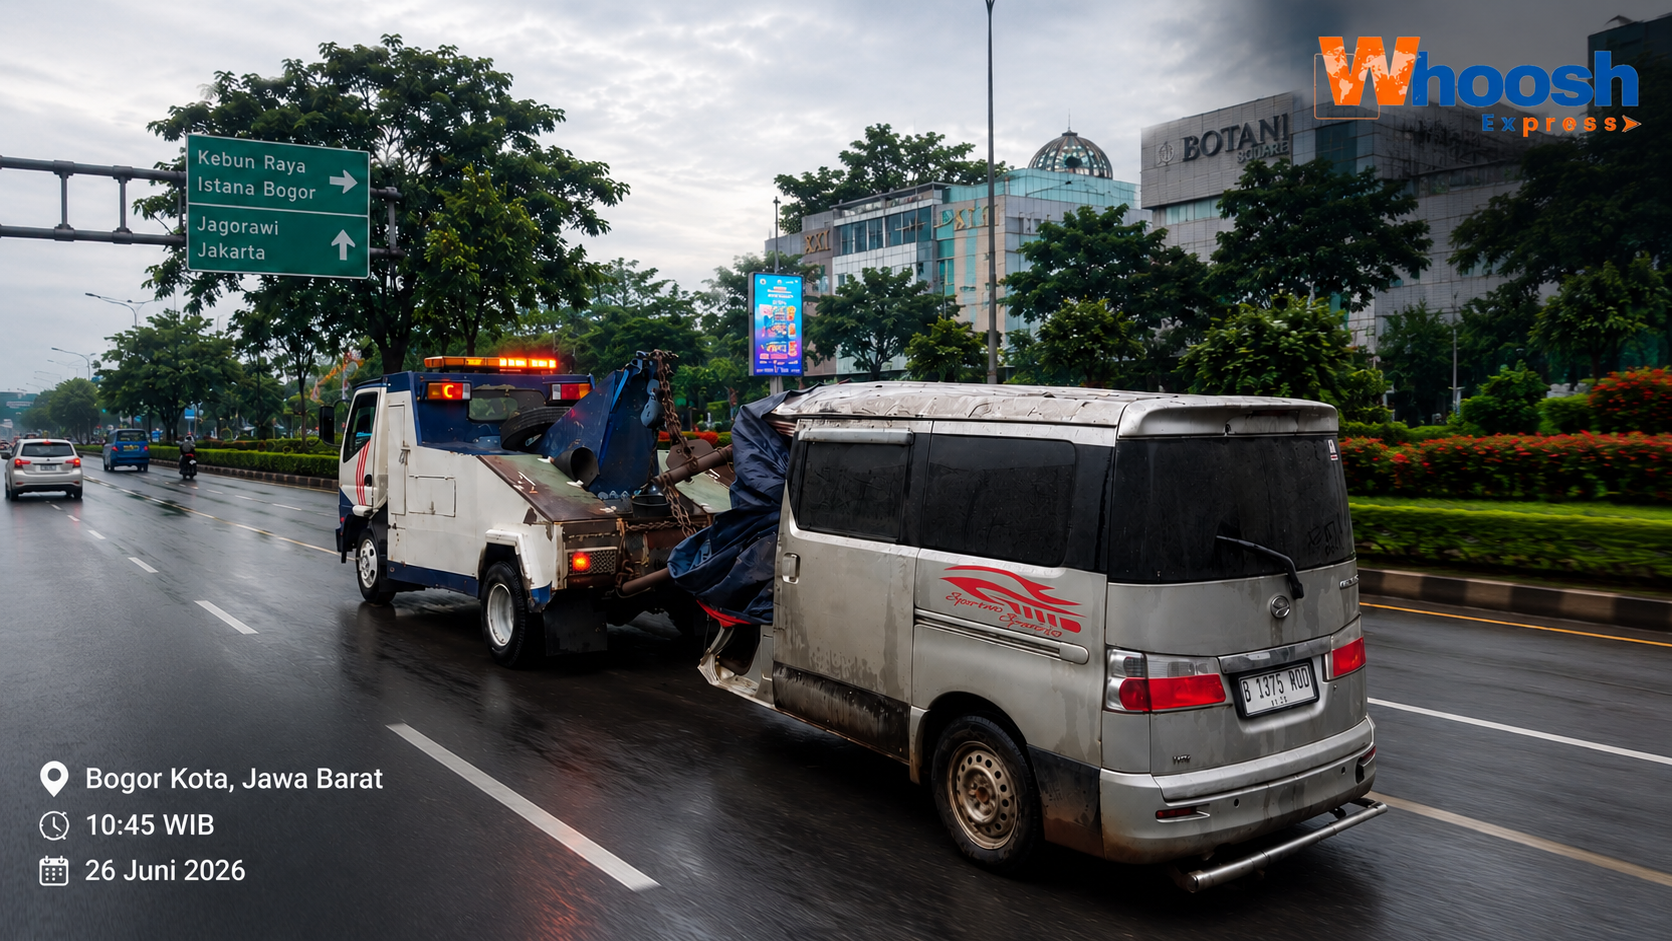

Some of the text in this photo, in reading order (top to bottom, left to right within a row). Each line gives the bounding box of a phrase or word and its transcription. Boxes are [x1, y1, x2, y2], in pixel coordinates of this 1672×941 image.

[1182, 113, 1290, 162] BOTANI
[198, 150, 306, 175] Kebun Raya
[198, 176, 316, 202] Istana Bogor
[197, 216, 279, 236] Jagorawi
[197, 242, 265, 260] Jakarta
[804, 230, 831, 254] XXI
[1243, 681, 1251, 702] B
[1256, 674, 1284, 699] 1375
